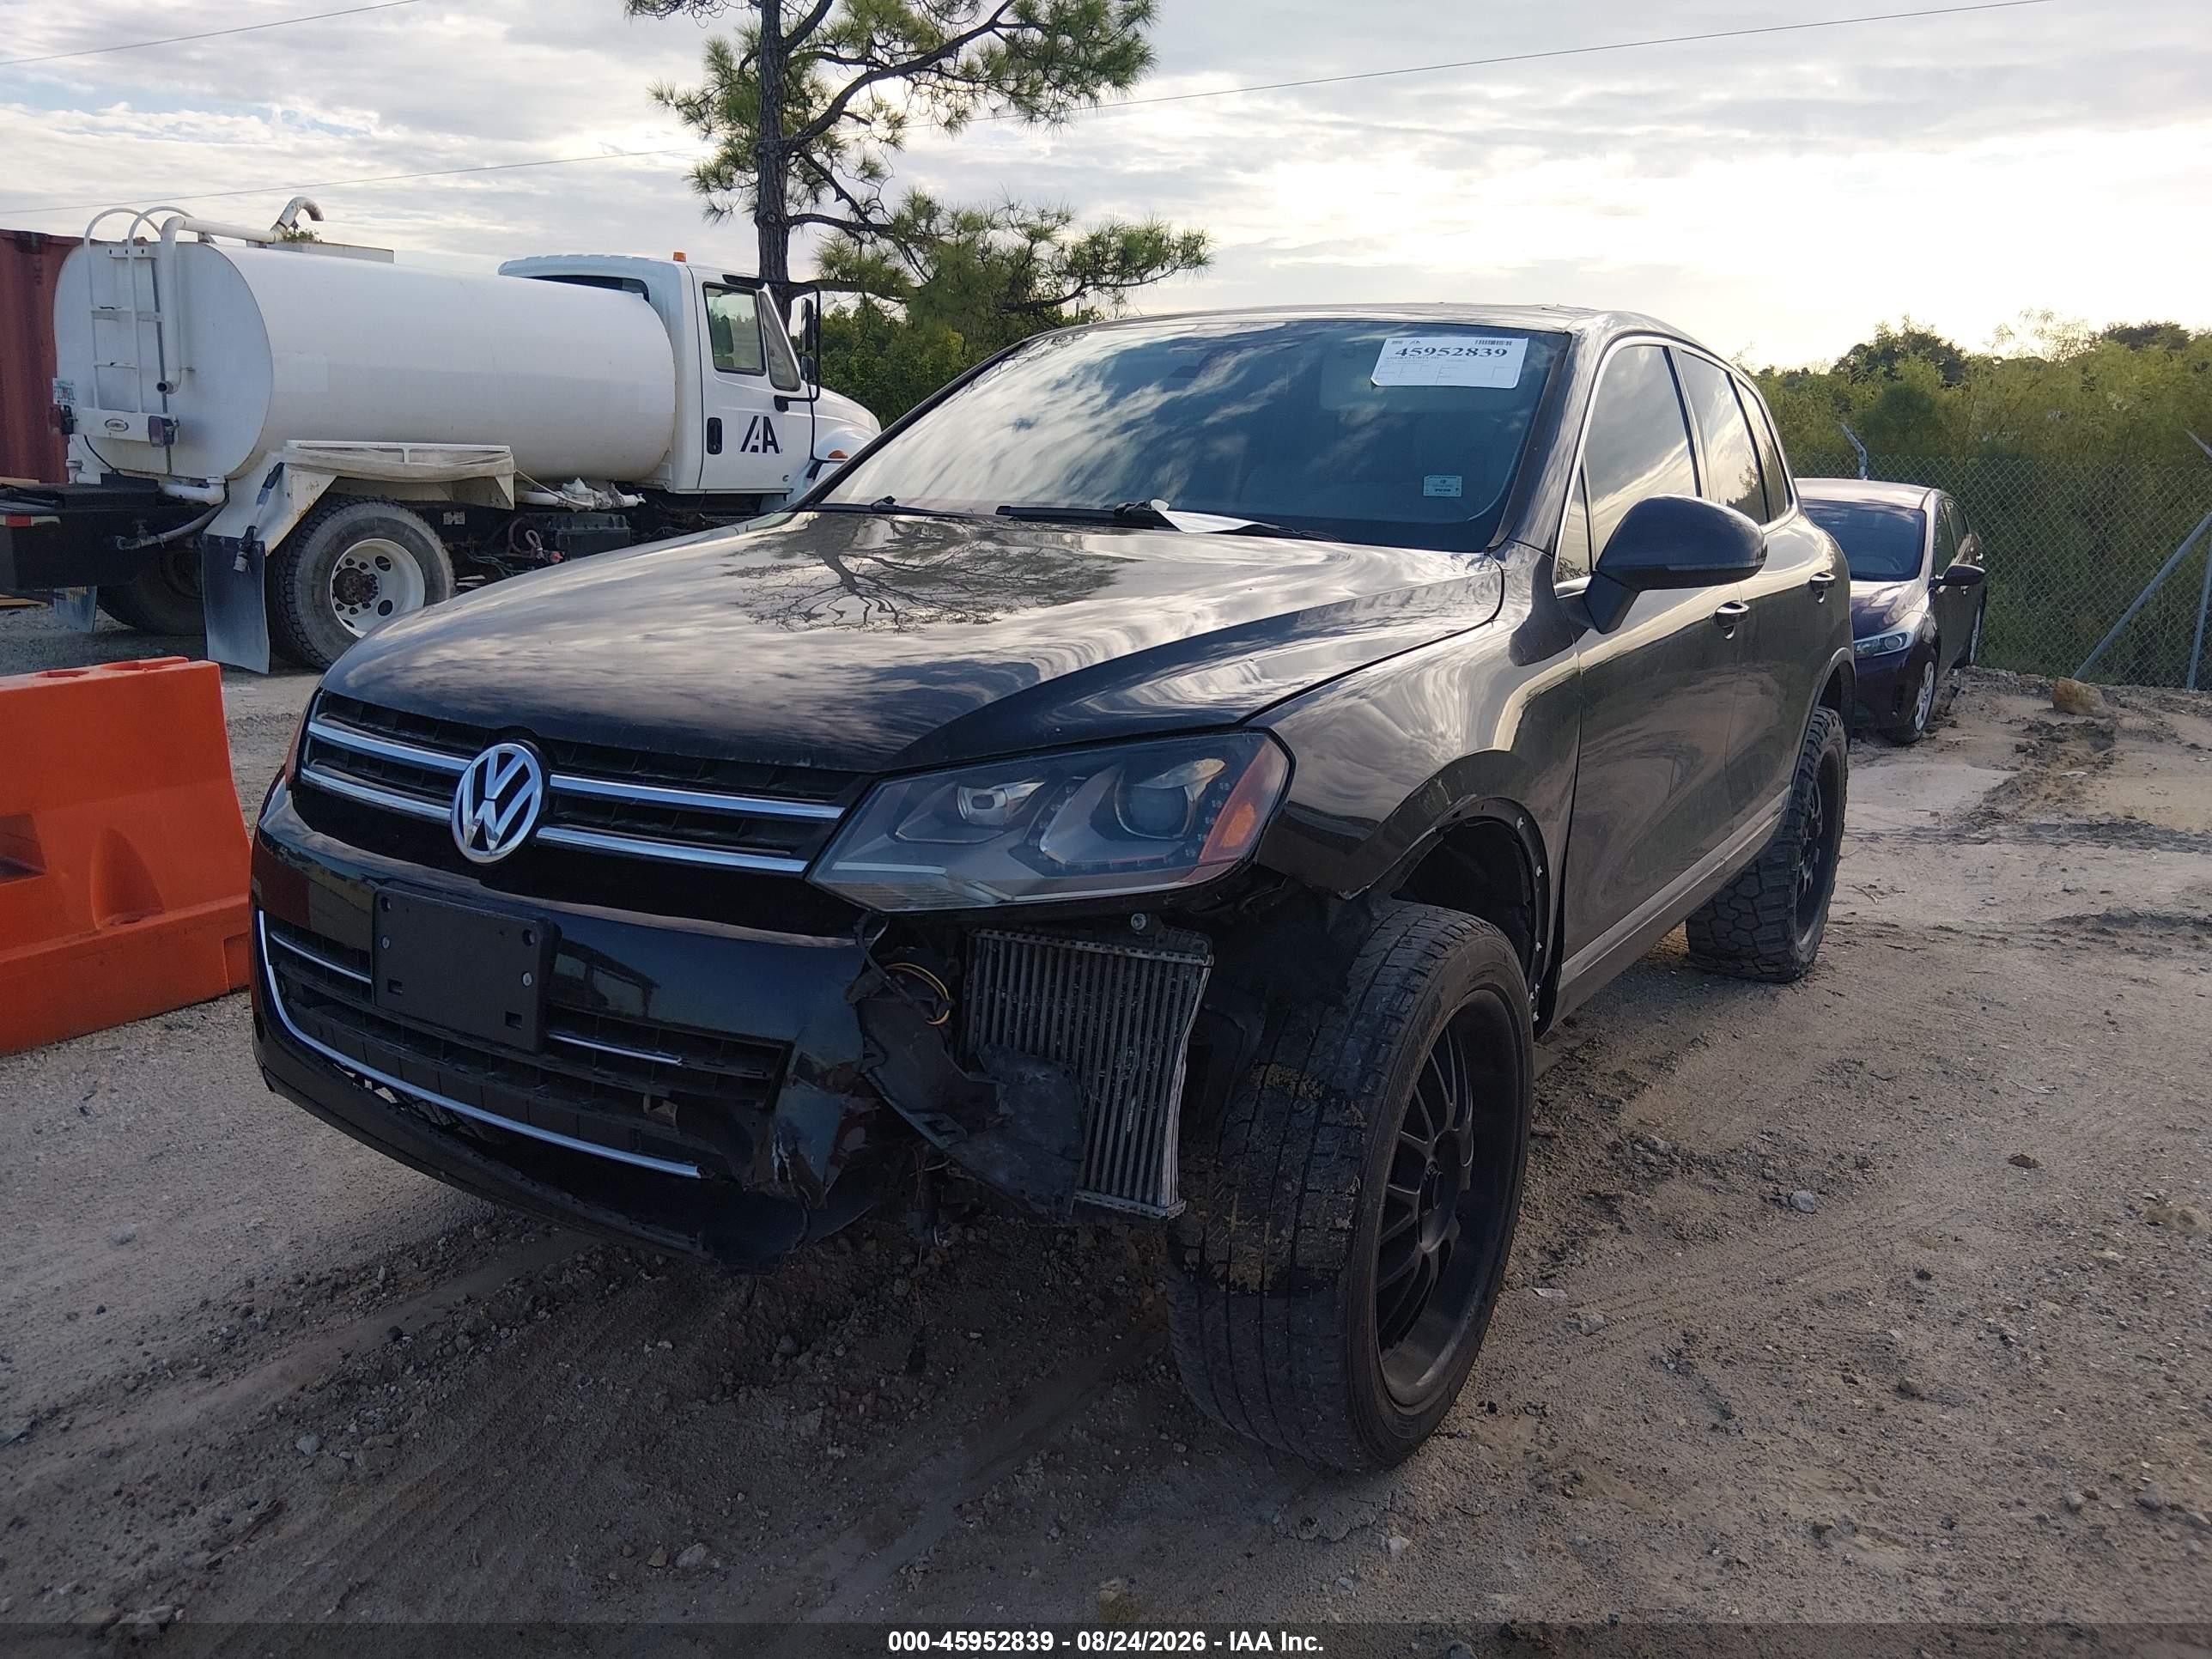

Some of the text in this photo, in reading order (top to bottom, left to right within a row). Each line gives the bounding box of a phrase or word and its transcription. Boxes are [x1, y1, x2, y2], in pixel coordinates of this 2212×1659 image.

[1395, 348, 1508, 357] 45952839
[739, 415, 781, 454] IAA
[453, 743, 543, 863] VW
